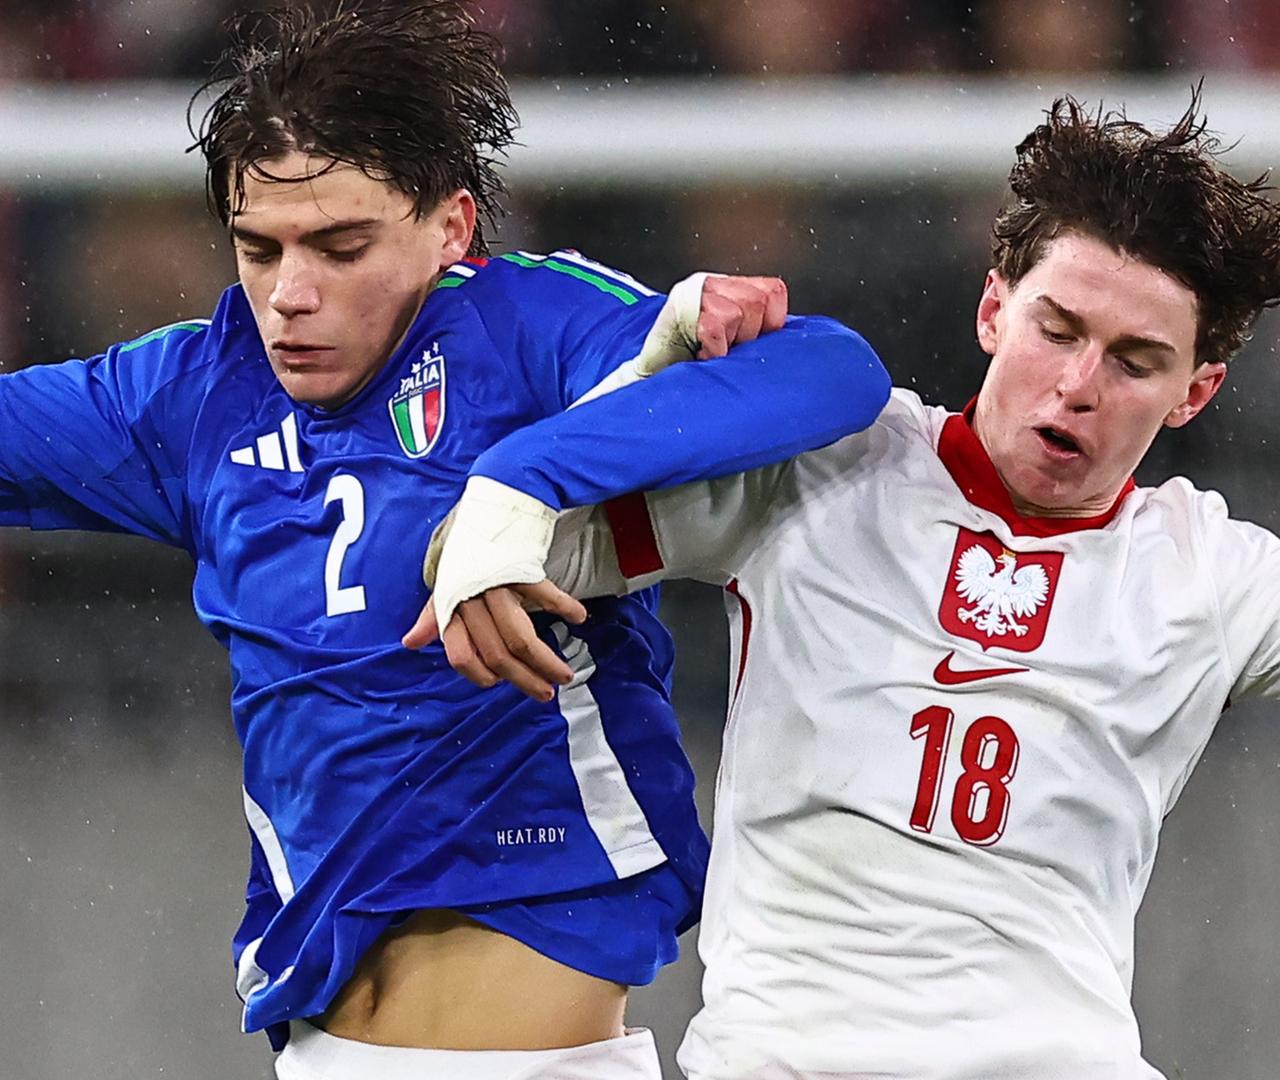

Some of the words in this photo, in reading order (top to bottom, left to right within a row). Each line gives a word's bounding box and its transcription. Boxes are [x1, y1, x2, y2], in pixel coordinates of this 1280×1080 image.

[323, 473, 367, 618] 2
[496, 826, 566, 846] HEAT.RDY
[909, 705, 1021, 847] 18
